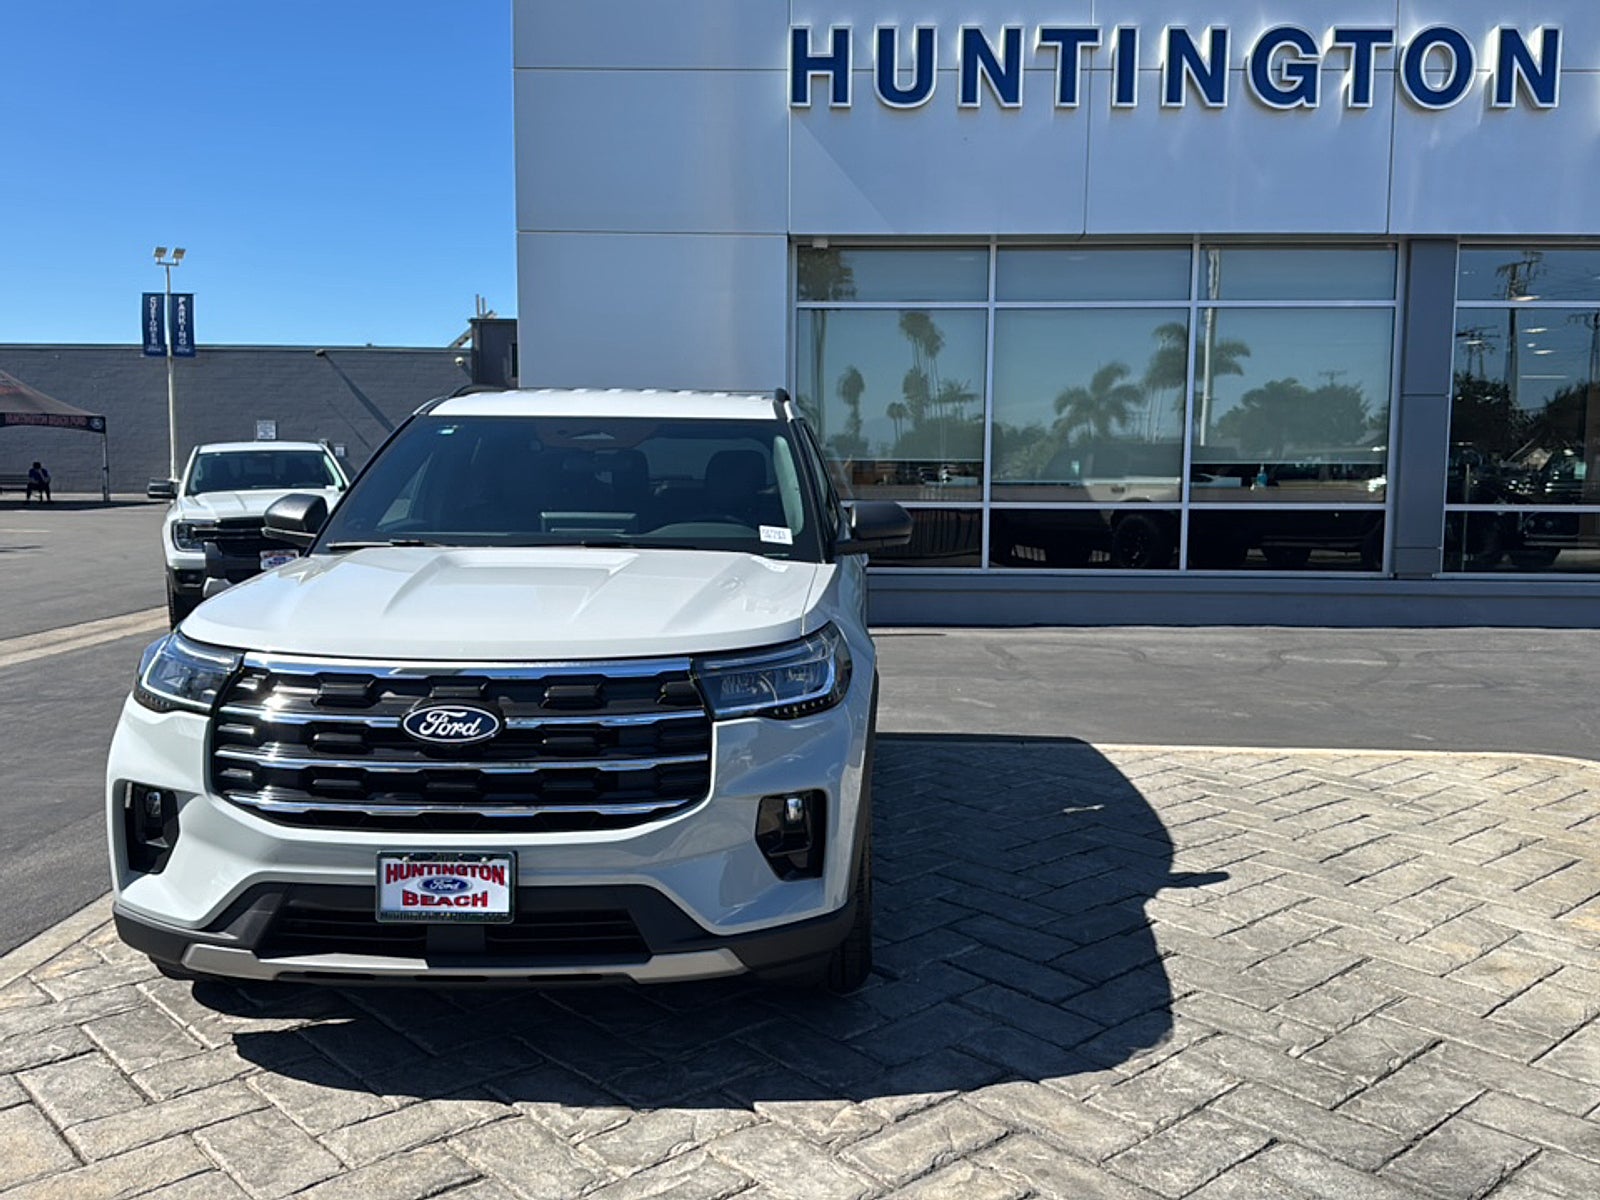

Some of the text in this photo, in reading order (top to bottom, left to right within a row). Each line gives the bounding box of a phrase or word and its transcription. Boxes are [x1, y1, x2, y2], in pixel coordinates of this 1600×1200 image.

[789, 25, 1562, 109] HUNTINGTON
[178, 296, 187, 345] PARKING
[419, 710, 482, 736] Ford
[386, 863, 505, 886] HUNTINGTON
[430, 879, 461, 890] Ford
[402, 889, 488, 908] BEACH
